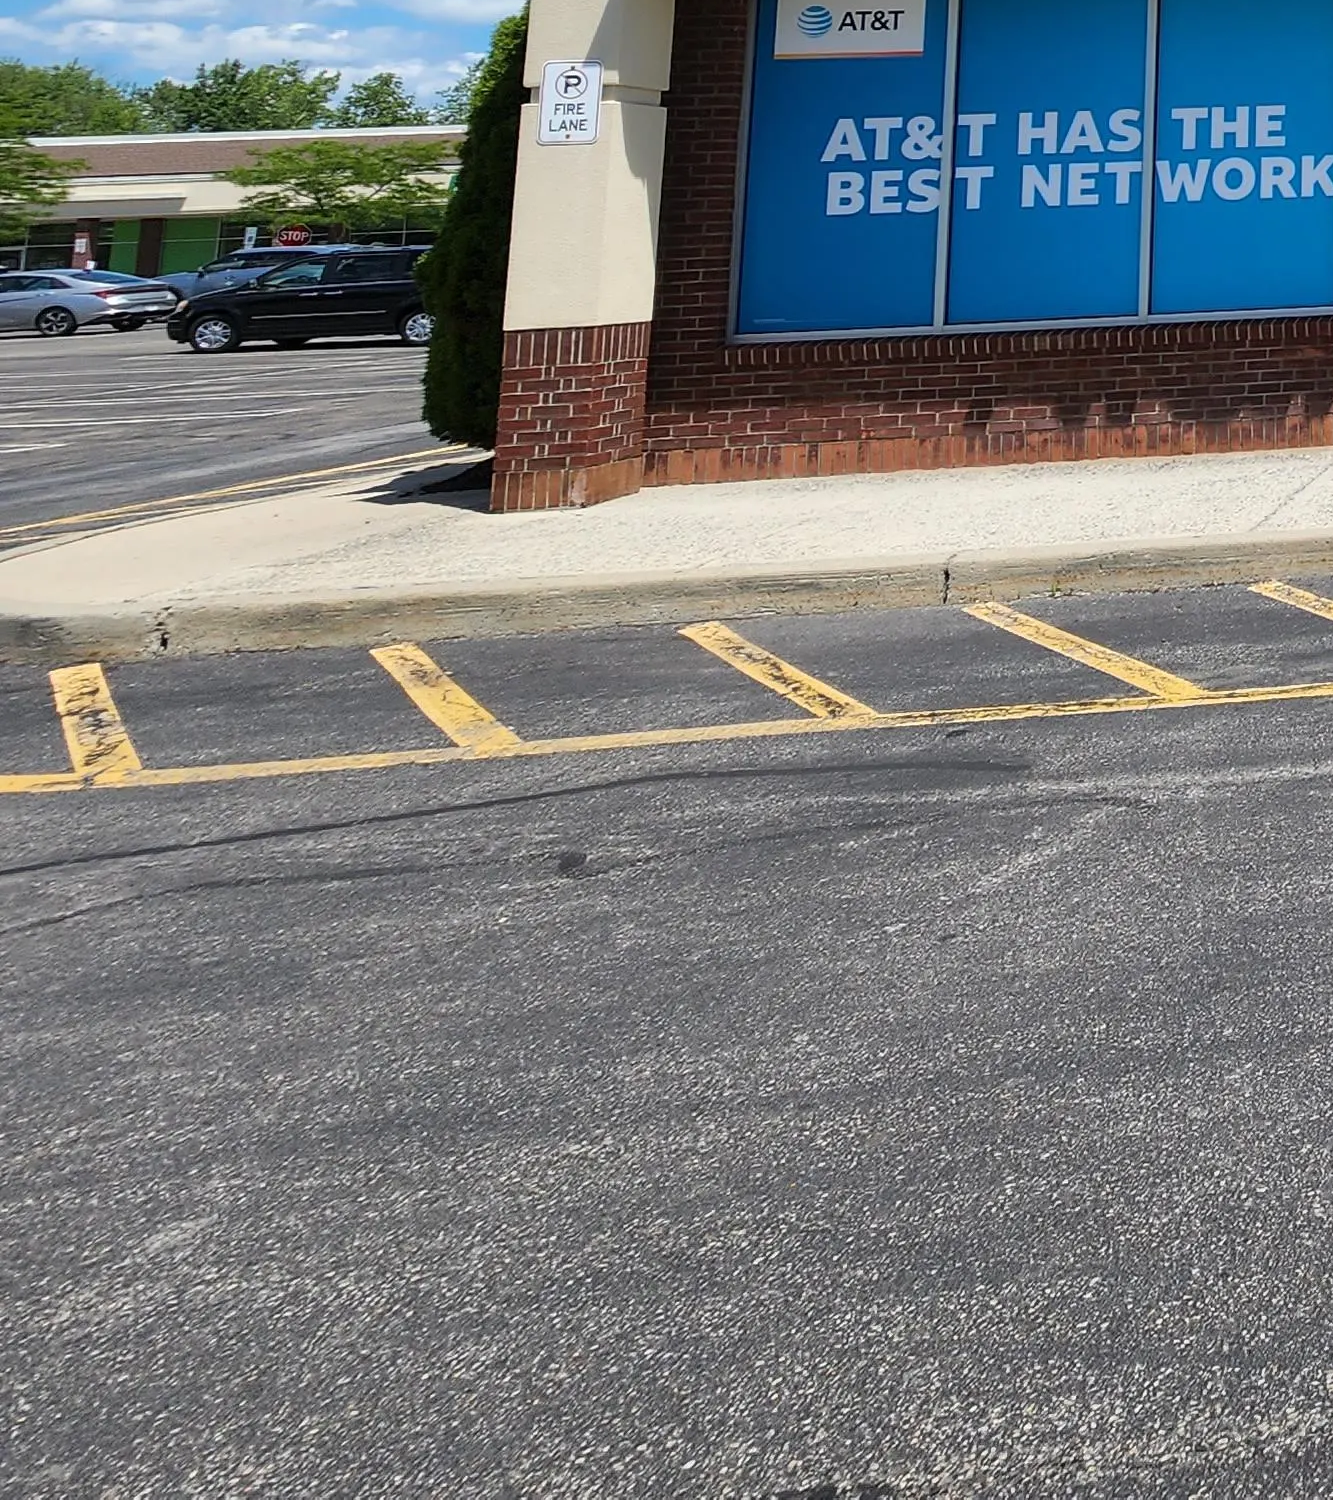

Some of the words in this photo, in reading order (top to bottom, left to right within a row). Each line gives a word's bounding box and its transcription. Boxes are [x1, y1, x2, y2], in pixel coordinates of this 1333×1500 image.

[838, 10, 904, 31] AT&T
[554, 103, 586, 115] FIRE
[548, 119, 588, 132] LANE
[821, 113, 996, 162] AT&T
[1017, 109, 1141, 155] HAS
[1171, 105, 1286, 150] THE
[826, 166, 994, 216] BEST
[280, 231, 309, 241] STOP
